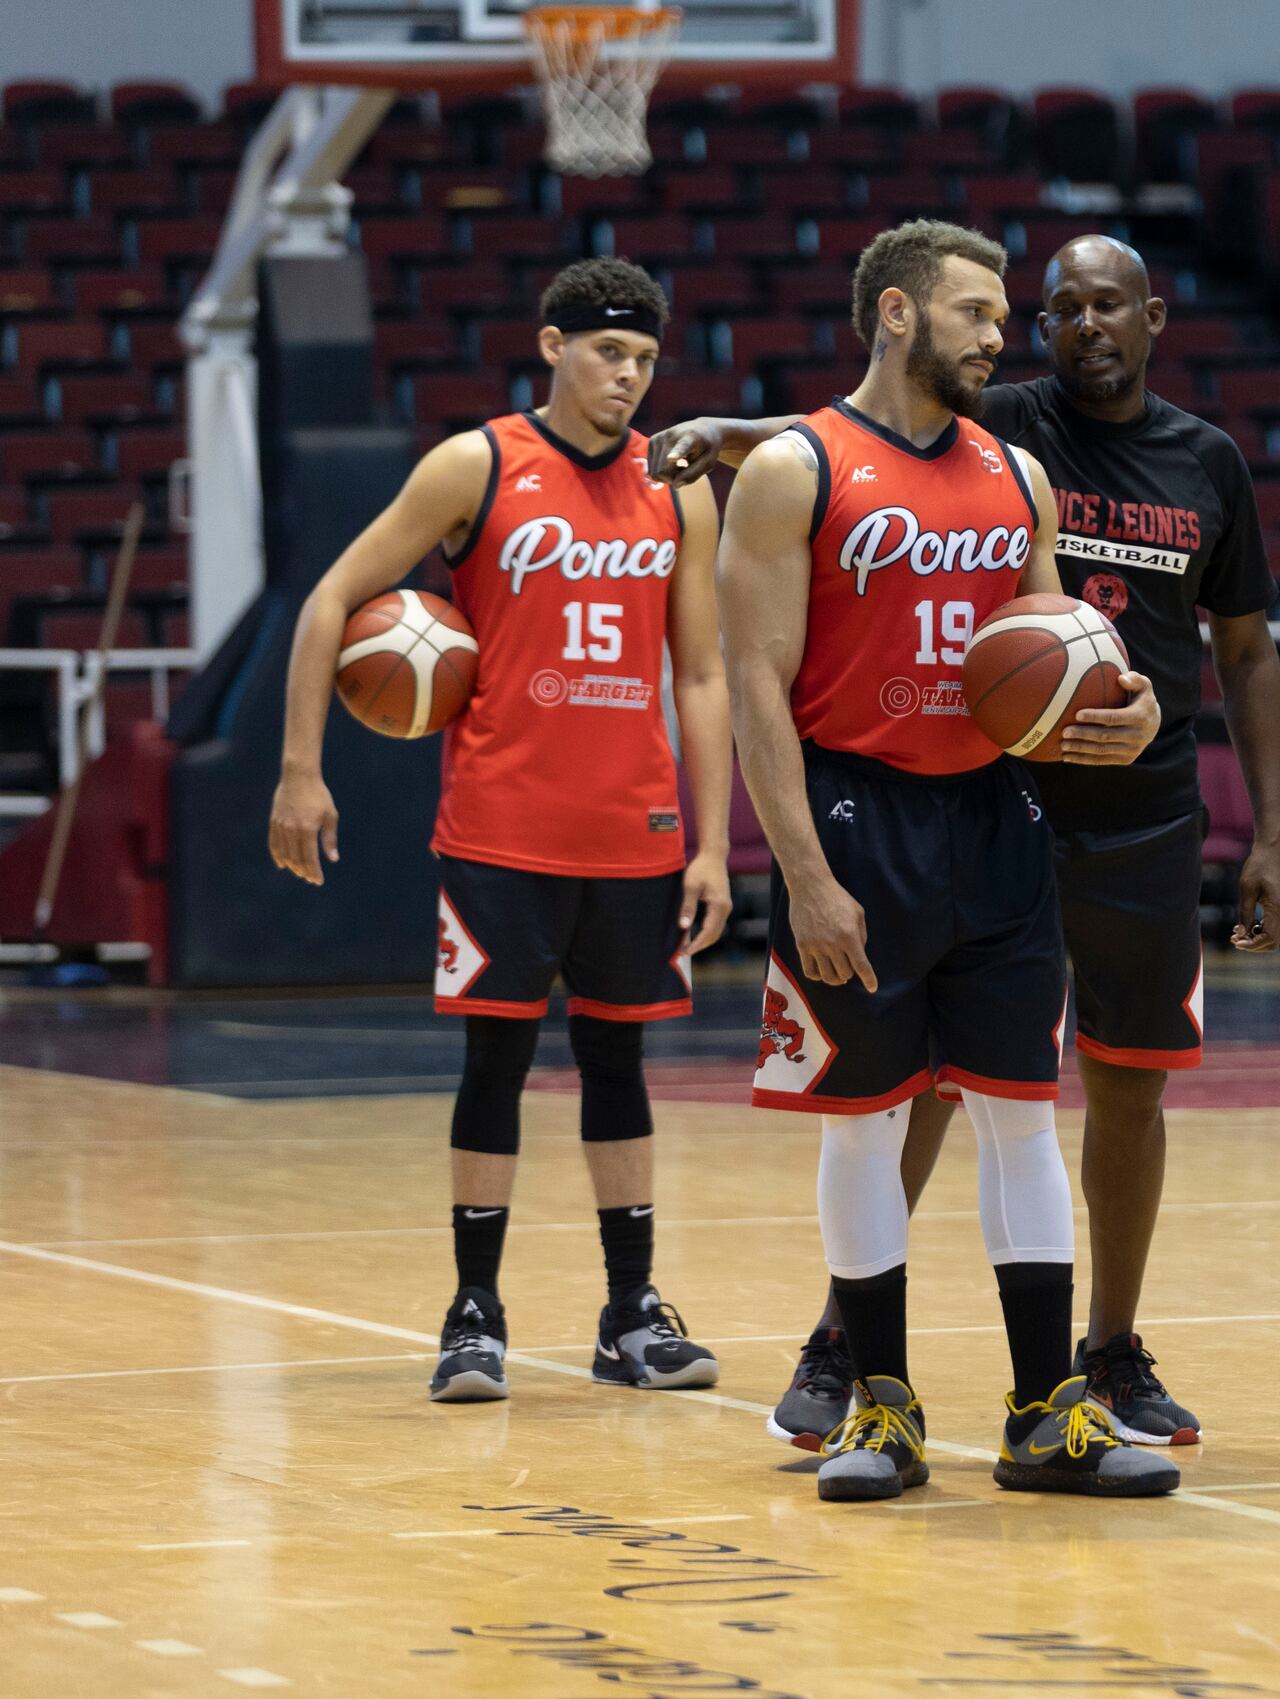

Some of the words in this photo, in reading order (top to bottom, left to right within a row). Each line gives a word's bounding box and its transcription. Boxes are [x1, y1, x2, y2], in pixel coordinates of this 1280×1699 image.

[515, 474, 543, 490] AC
[852, 465, 877, 481] AC
[1051, 487, 1101, 535] NCE
[1105, 498, 1201, 551] LEONES
[499, 515, 677, 596] Ponce
[838, 505, 1031, 596] Ponce
[1055, 538, 1183, 570] ASKETBALL
[562, 601, 624, 663] 15
[914, 600, 975, 666] 19
[568, 679, 653, 702] TARGET
[921, 687, 968, 707] TAR
